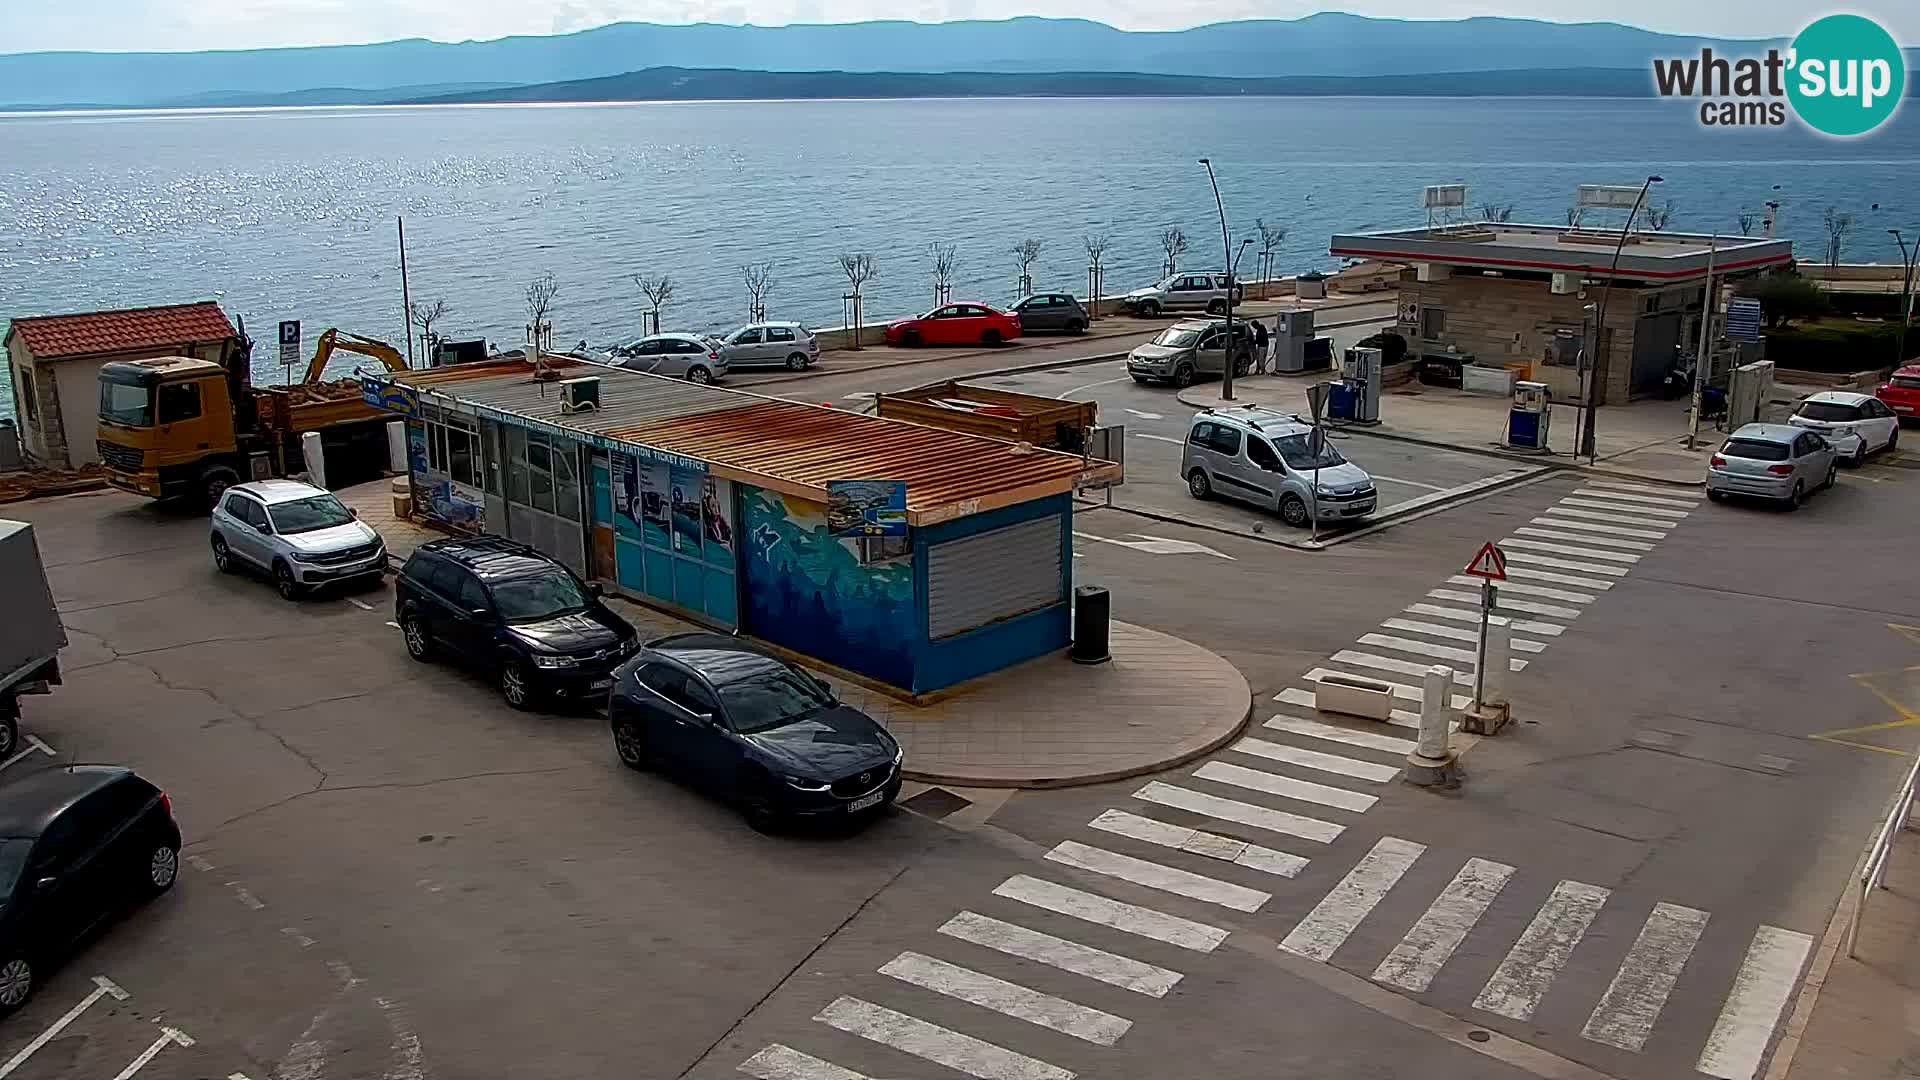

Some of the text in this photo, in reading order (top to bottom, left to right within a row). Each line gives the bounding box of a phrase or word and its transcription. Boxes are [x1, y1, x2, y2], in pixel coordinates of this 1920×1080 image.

[284, 324, 297, 341] P
[604, 439, 618, 451] BUS
[620, 443, 651, 459] STATION
[653, 450, 678, 465] TICKET
[680, 458, 706, 472] OFFICE
